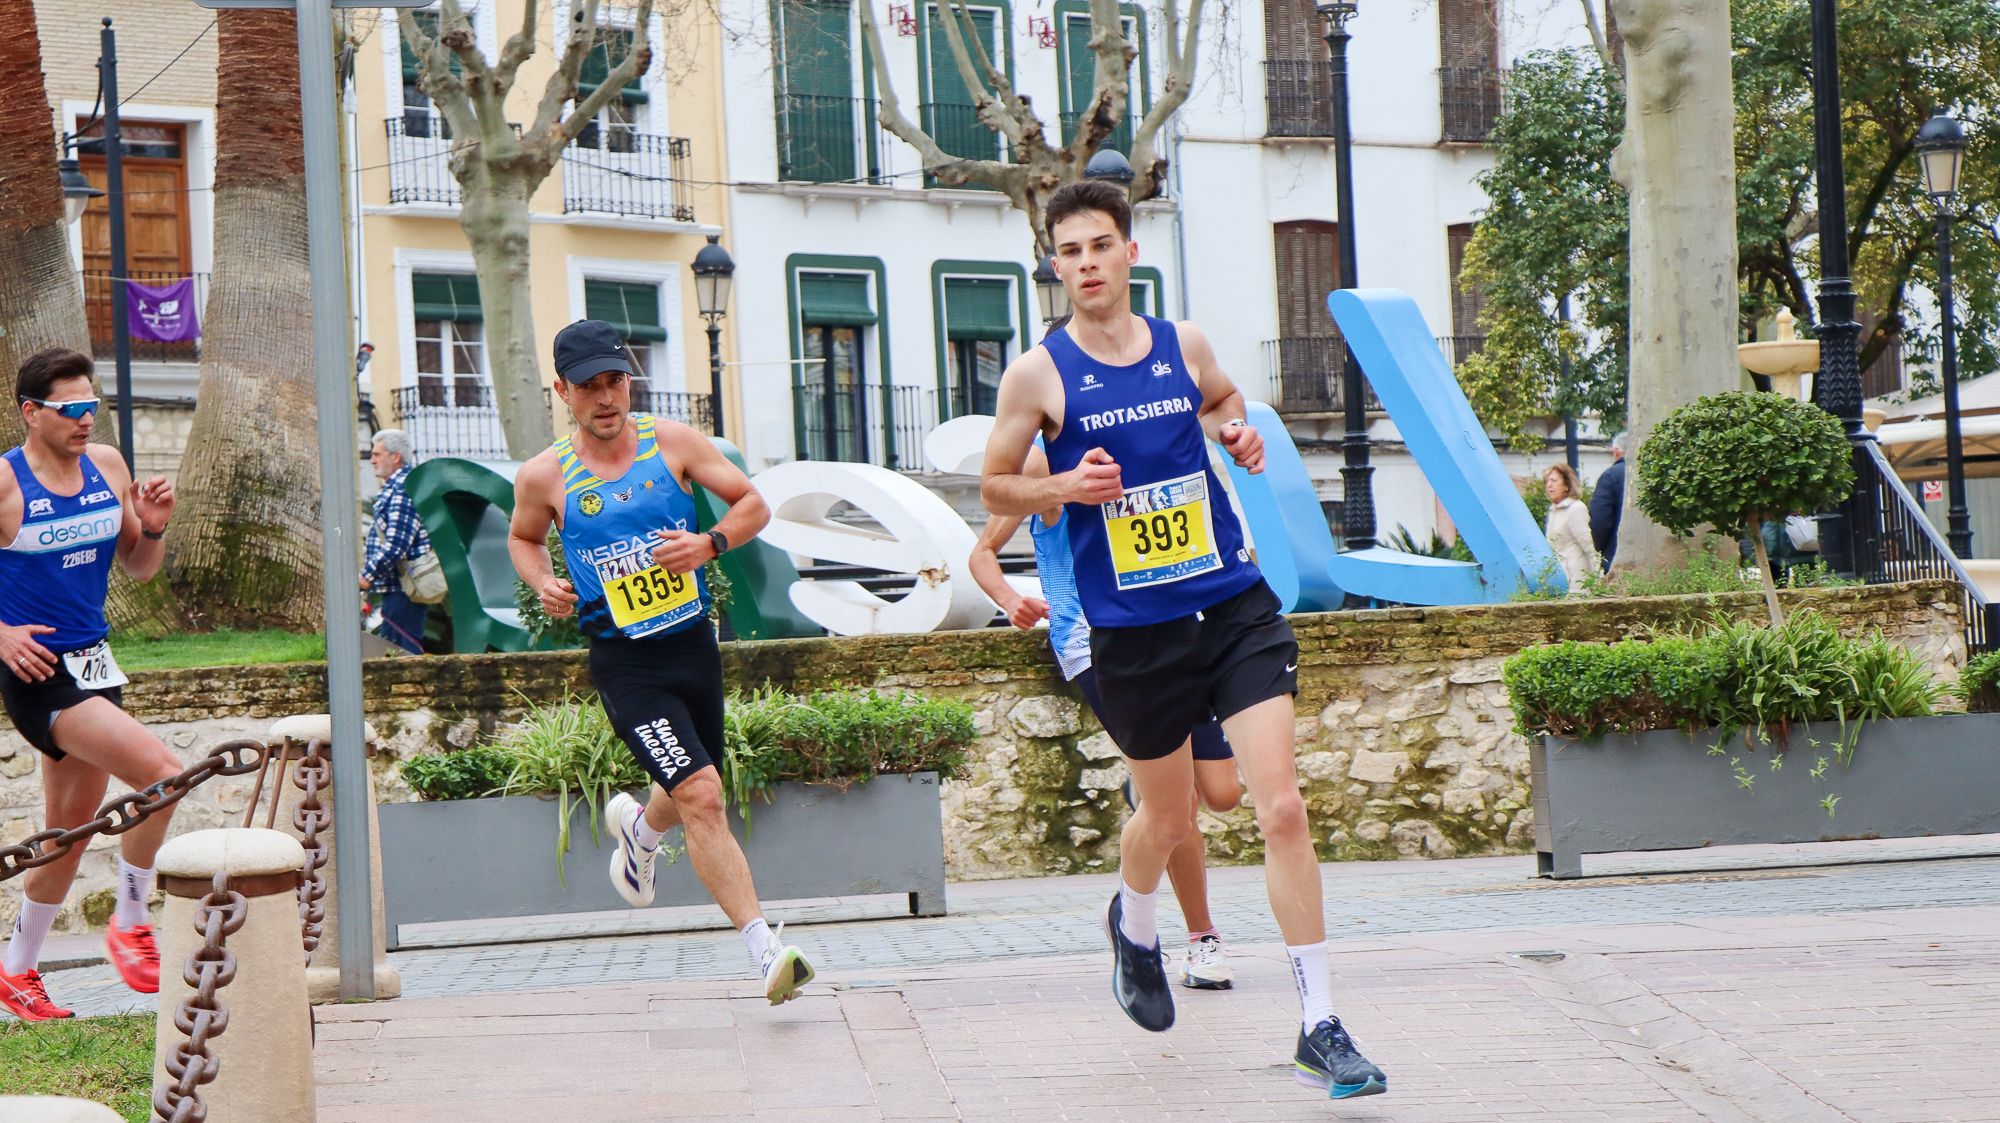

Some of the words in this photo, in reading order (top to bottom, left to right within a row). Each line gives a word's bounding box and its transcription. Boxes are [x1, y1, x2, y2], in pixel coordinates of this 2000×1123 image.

[1080, 396, 1193, 432] TROTASIERRA
[1116, 490, 1154, 518] 21K
[38, 517, 115, 545] desam
[1130, 509, 1190, 555] 393
[62, 548, 97, 569] 226ERS
[608, 553, 642, 580] 21K
[617, 567, 685, 611] 1359
[634, 724, 678, 780] LUCENA
[651, 717, 693, 767] SURCO
